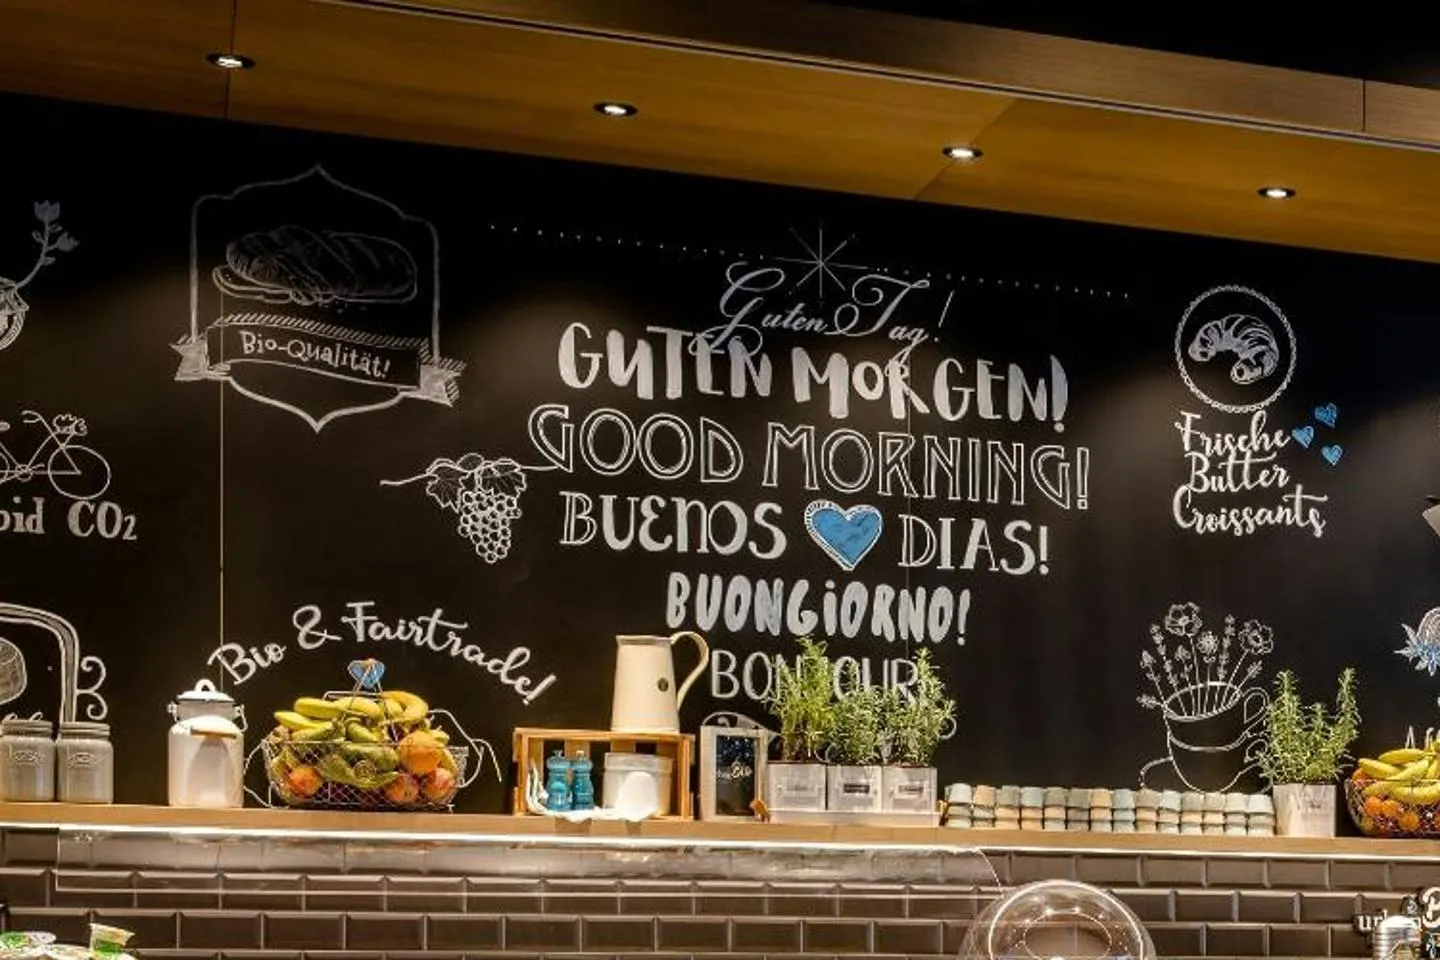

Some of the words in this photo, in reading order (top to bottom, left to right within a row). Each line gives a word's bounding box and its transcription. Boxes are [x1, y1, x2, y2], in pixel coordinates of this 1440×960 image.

[239, 330, 391, 378] Bio-Qualität!
[558, 322, 772, 399] GUTEN
[792, 346, 1069, 432] MORGEN!
[528, 403, 744, 483] GOOD
[762, 420, 1090, 510] MORNING!
[1175, 410, 1291, 459] Frische
[1185, 449, 1290, 493] Butter
[558, 491, 787, 560] BUENOS
[898, 514, 1051, 576] DIAS!
[1172, 484, 1330, 538] Croissants
[666, 571, 970, 646] BUONGIORNO!
[208, 641, 287, 685] Bio
[292, 605, 344, 651] &
[343, 601, 557, 706] Fairtrade!
[711, 650, 918, 704] BONOUR
